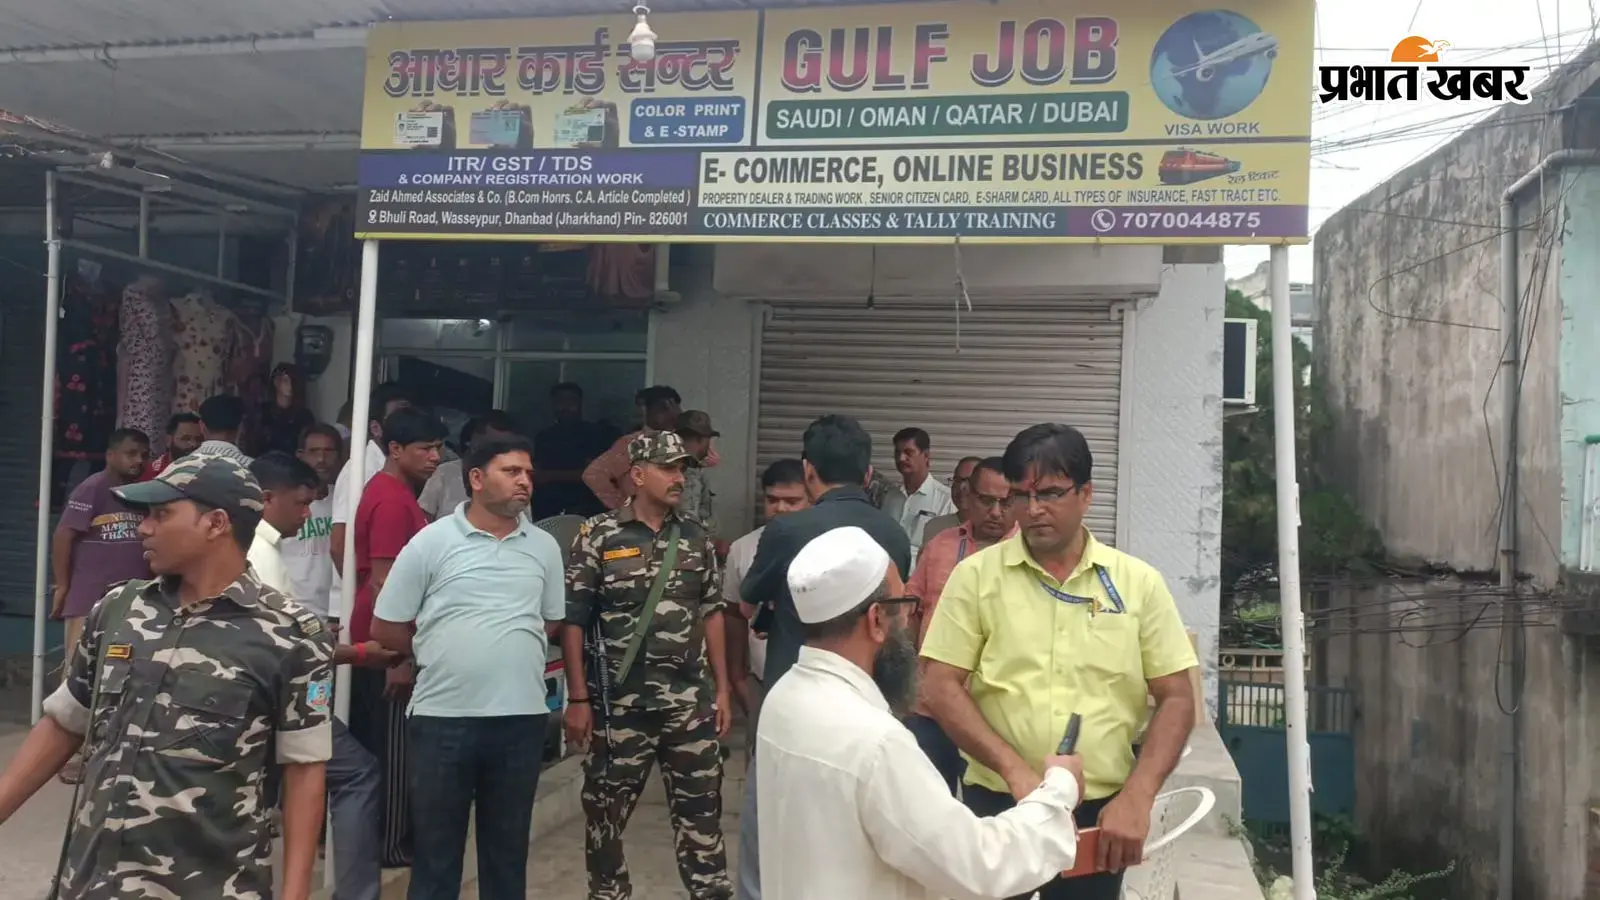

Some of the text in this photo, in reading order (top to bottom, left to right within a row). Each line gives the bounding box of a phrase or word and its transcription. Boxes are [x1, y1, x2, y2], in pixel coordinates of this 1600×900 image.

[384, 48, 510, 97] आधार
[514, 27, 613, 95] कार्ड
[781, 17, 1120, 93] GULF JOB
[634, 103, 741, 118] COLOR PRINT
[776, 108, 841, 129] SAUDI
[860, 106, 926, 127] OMAN
[946, 103, 1023, 127] QATAR
[1043, 101, 1118, 124] DUBAI
[644, 127, 656, 138] &
[1165, 123, 1260, 136] VISA WORK
[492, 156, 534, 171] GST
[552, 156, 593, 171] TDS
[734, 156, 885, 190] COMMERCE,
[893, 155, 993, 183] ONLINE
[1002, 152, 1144, 181] BUSINESS
[399, 173, 643, 184] & COMPANY REGISTRATION WORK
[370, 190, 390, 202] Zaid
[391, 190, 424, 202] Ahmed
[425, 190, 475, 203] Associates
[477, 191, 485, 203] &
[505, 190, 540, 205] (B.Com
[575, 190, 595, 204] C.A.
[598, 190, 629, 203] Article
[631, 190, 685, 206] Completed
[702, 193, 748, 204] PROPERTY
[750, 192, 785, 204] DEALER
[786, 192, 794, 204] &
[794, 192, 834, 204] TRADING
[835, 192, 863, 204] WORK
[869, 192, 903, 204] SENIOR
[905, 192, 941, 204] CITIZEN
[976, 191, 1019, 203] E-SHARM
[1053, 191, 1072, 203] ALL
[1074, 190, 1106, 203] TYPES
[1108, 190, 1122, 203] OF
[1192, 190, 1217, 203] FAST
[1220, 189, 1256, 202] TRACT
[379, 210, 688, 228] Bhuli Road, Wasseypur, Dhanbad (Jharkhand) Pin- 826001
[703, 212, 1056, 229] COMMERCE CLASSES & TALLY TRAINING
[1122, 212, 1261, 228] 7070044875
